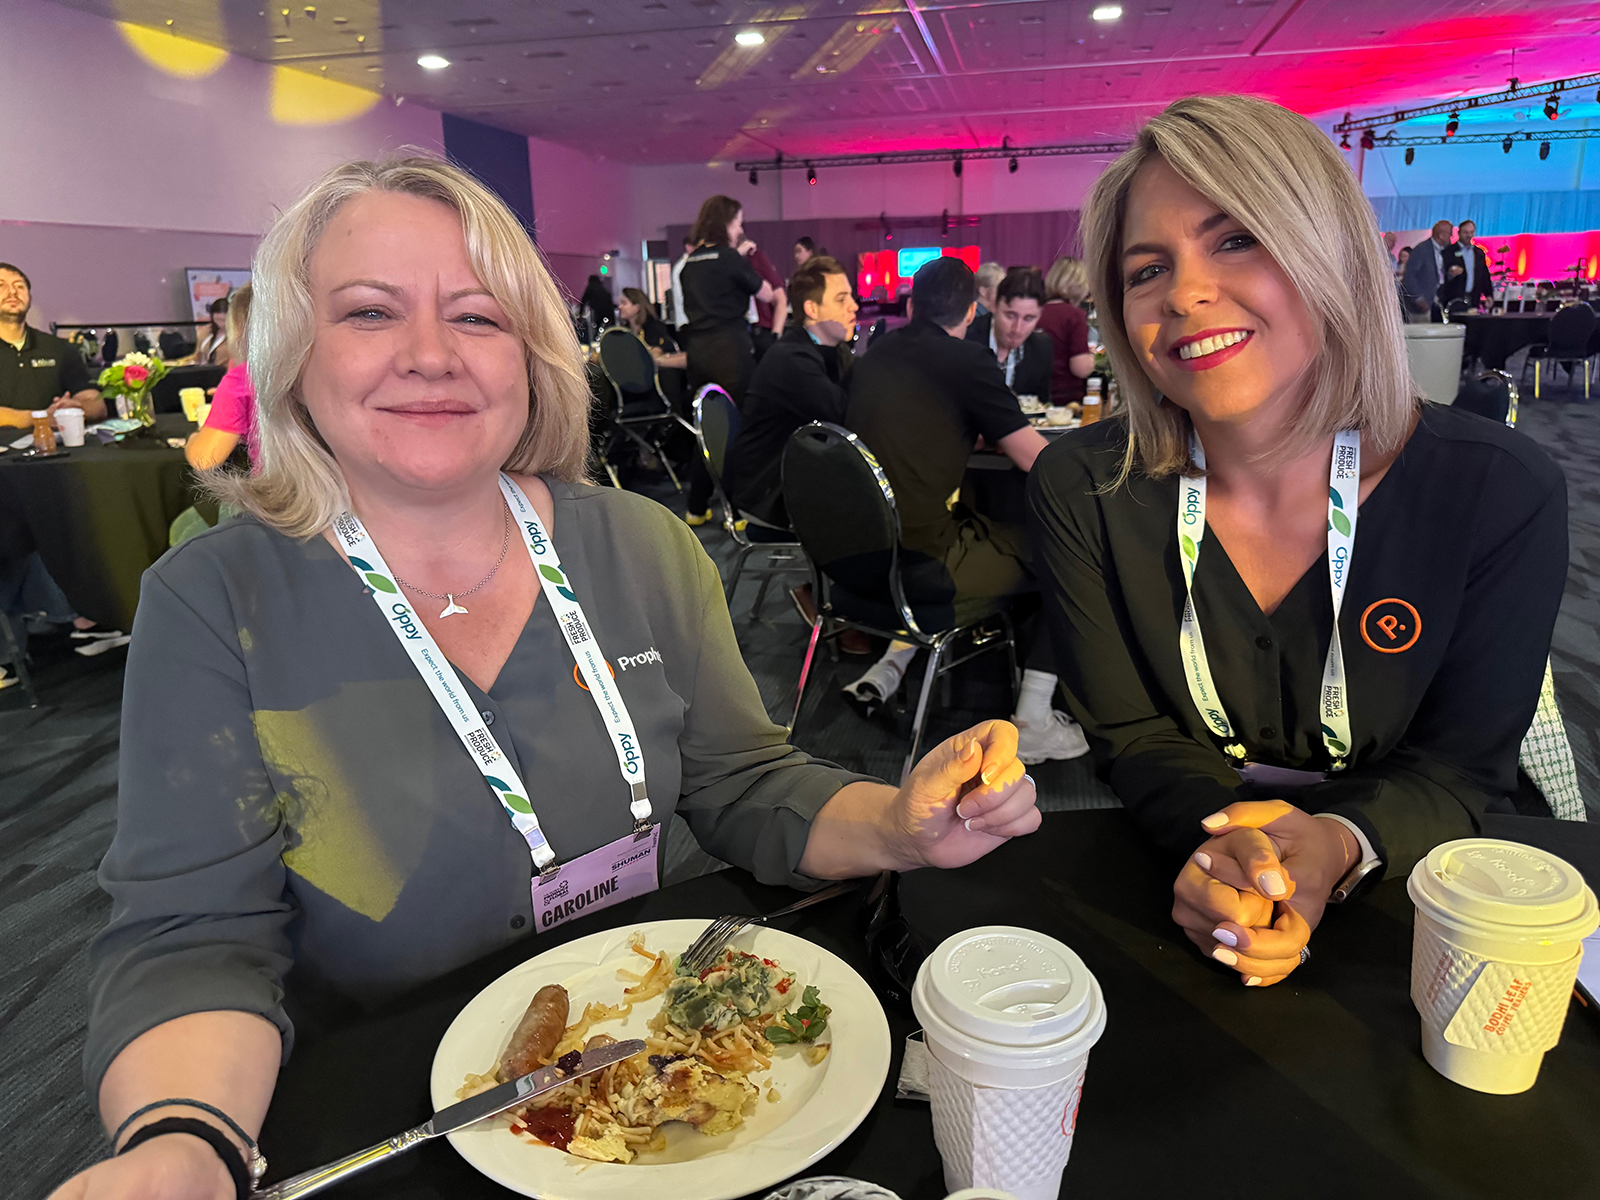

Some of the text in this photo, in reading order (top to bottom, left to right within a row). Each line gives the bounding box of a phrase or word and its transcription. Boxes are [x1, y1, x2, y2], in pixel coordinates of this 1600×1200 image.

[1336, 445, 1346, 479] PRODUCE
[1346, 446, 1354, 470] FRESH
[1182, 487, 1202, 525] Oppy
[335, 516, 356, 547] PRODUCE
[342, 511, 358, 534] FRESH
[524, 520, 546, 555] Oppy
[1331, 546, 1348, 588] Oppy
[392, 603, 422, 640] Oppy
[566, 622, 581, 645] FRESH
[569, 610, 588, 642] PRODUCE
[587, 656, 598, 673] from
[617, 647, 663, 671] Proph
[1191, 655, 1199, 674] world
[421, 648, 470, 723] Expect the world from us
[594, 673, 606, 691] world
[602, 690, 611, 701] the
[1198, 682, 1208, 702] Expect
[607, 701, 621, 723] Expect
[1326, 685, 1334, 718] PRODUCE
[1332, 686, 1340, 710] FRESH
[467, 732, 493, 766] PRODUCE
[474, 728, 494, 753] FRESH
[618, 732, 640, 774] Oppy
[612, 849, 651, 870] SHUMAN
[542, 875, 620, 927] CAROLINE
[1483, 978, 1524, 1033] BODHI LEAF
[1495, 982, 1532, 1036] COFFEE TRADERS
